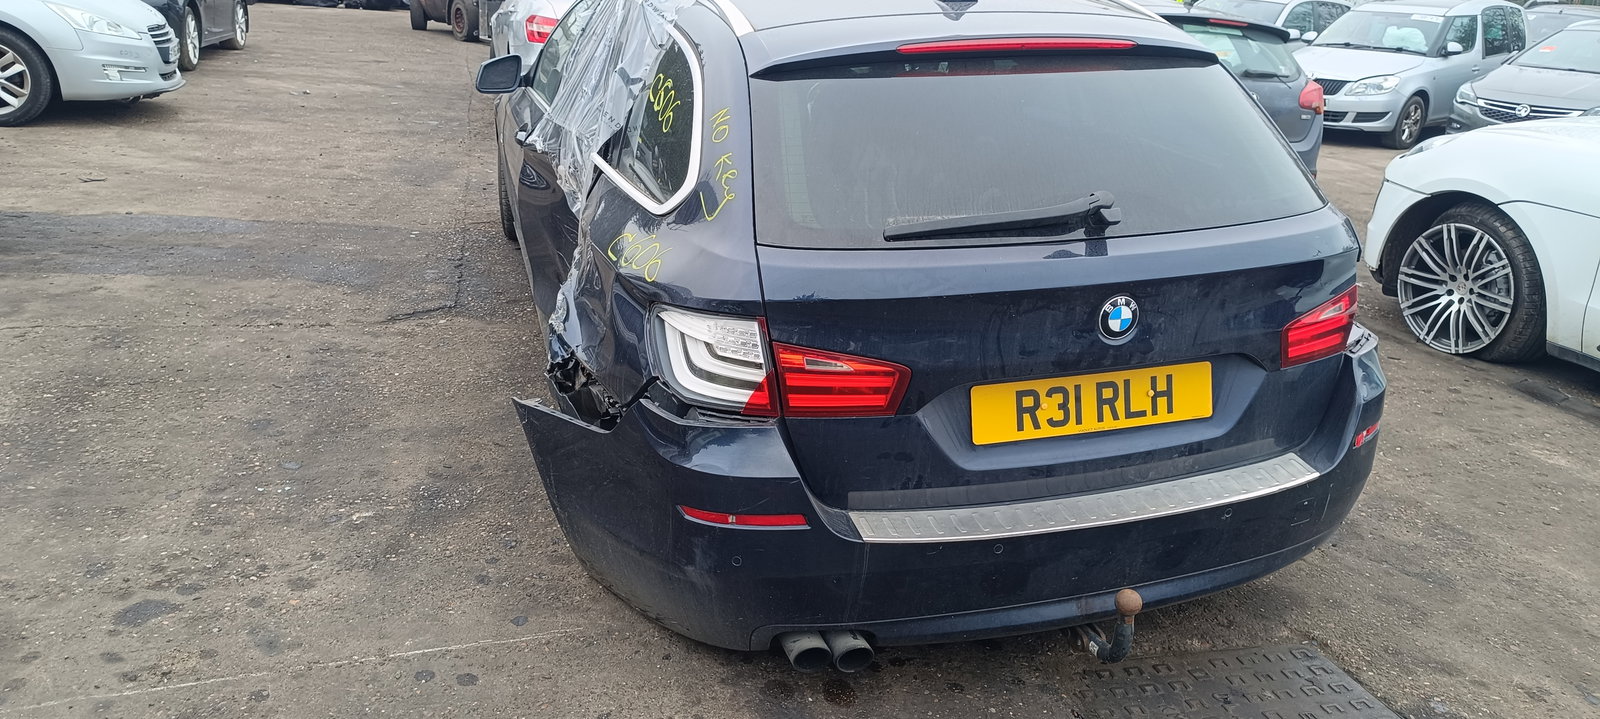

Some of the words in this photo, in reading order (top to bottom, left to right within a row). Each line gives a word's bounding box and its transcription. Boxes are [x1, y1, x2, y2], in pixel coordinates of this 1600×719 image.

[710, 108, 731, 143] NO
[607, 232, 673, 283] C606
[1104, 298, 1138, 313] BMW
[1016, 383, 1082, 432] R31
[1096, 374, 1174, 424] RLH
